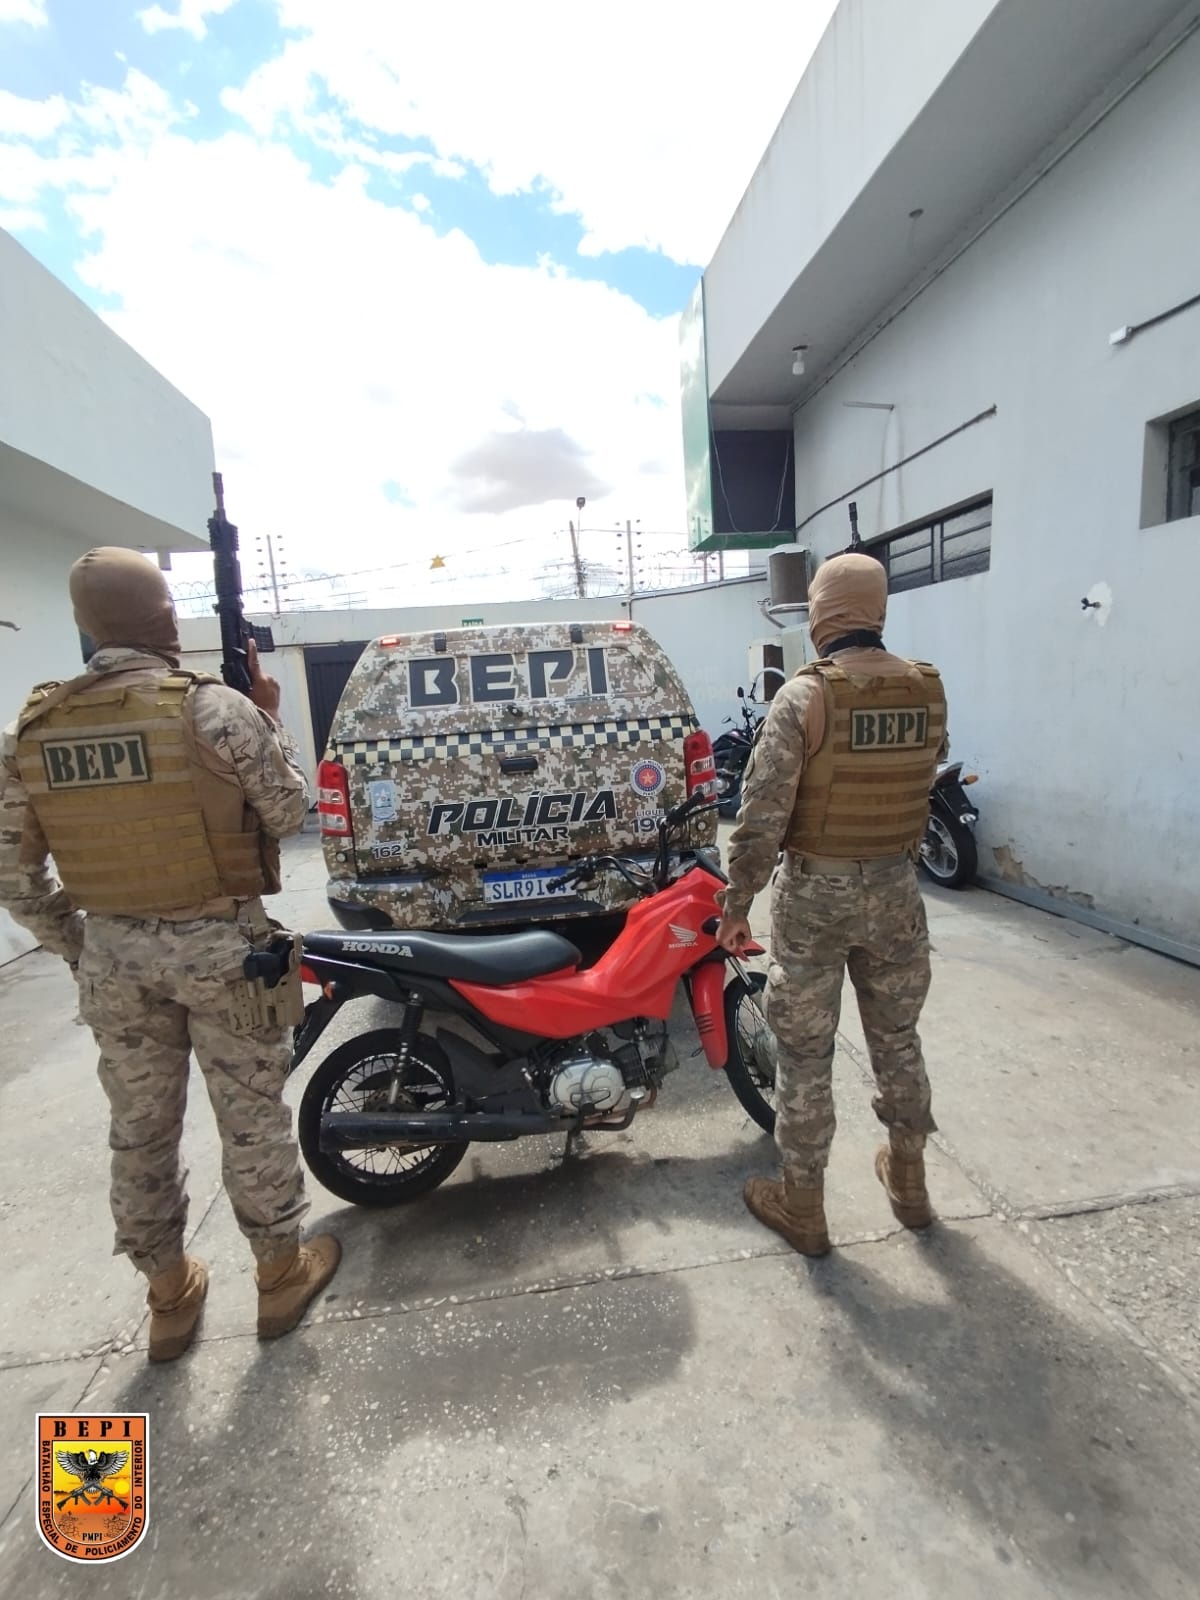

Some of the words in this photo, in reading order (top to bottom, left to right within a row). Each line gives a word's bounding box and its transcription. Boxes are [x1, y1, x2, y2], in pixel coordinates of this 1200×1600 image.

[407, 647, 608, 708] BEPI
[853, 711, 926, 746] BEPI
[46, 740, 145, 783] BEPI
[427, 790, 617, 836] POLÍCIA
[373, 844, 402, 859] 162
[477, 826, 571, 847] MILITAR
[341, 941, 414, 958] HONDA
